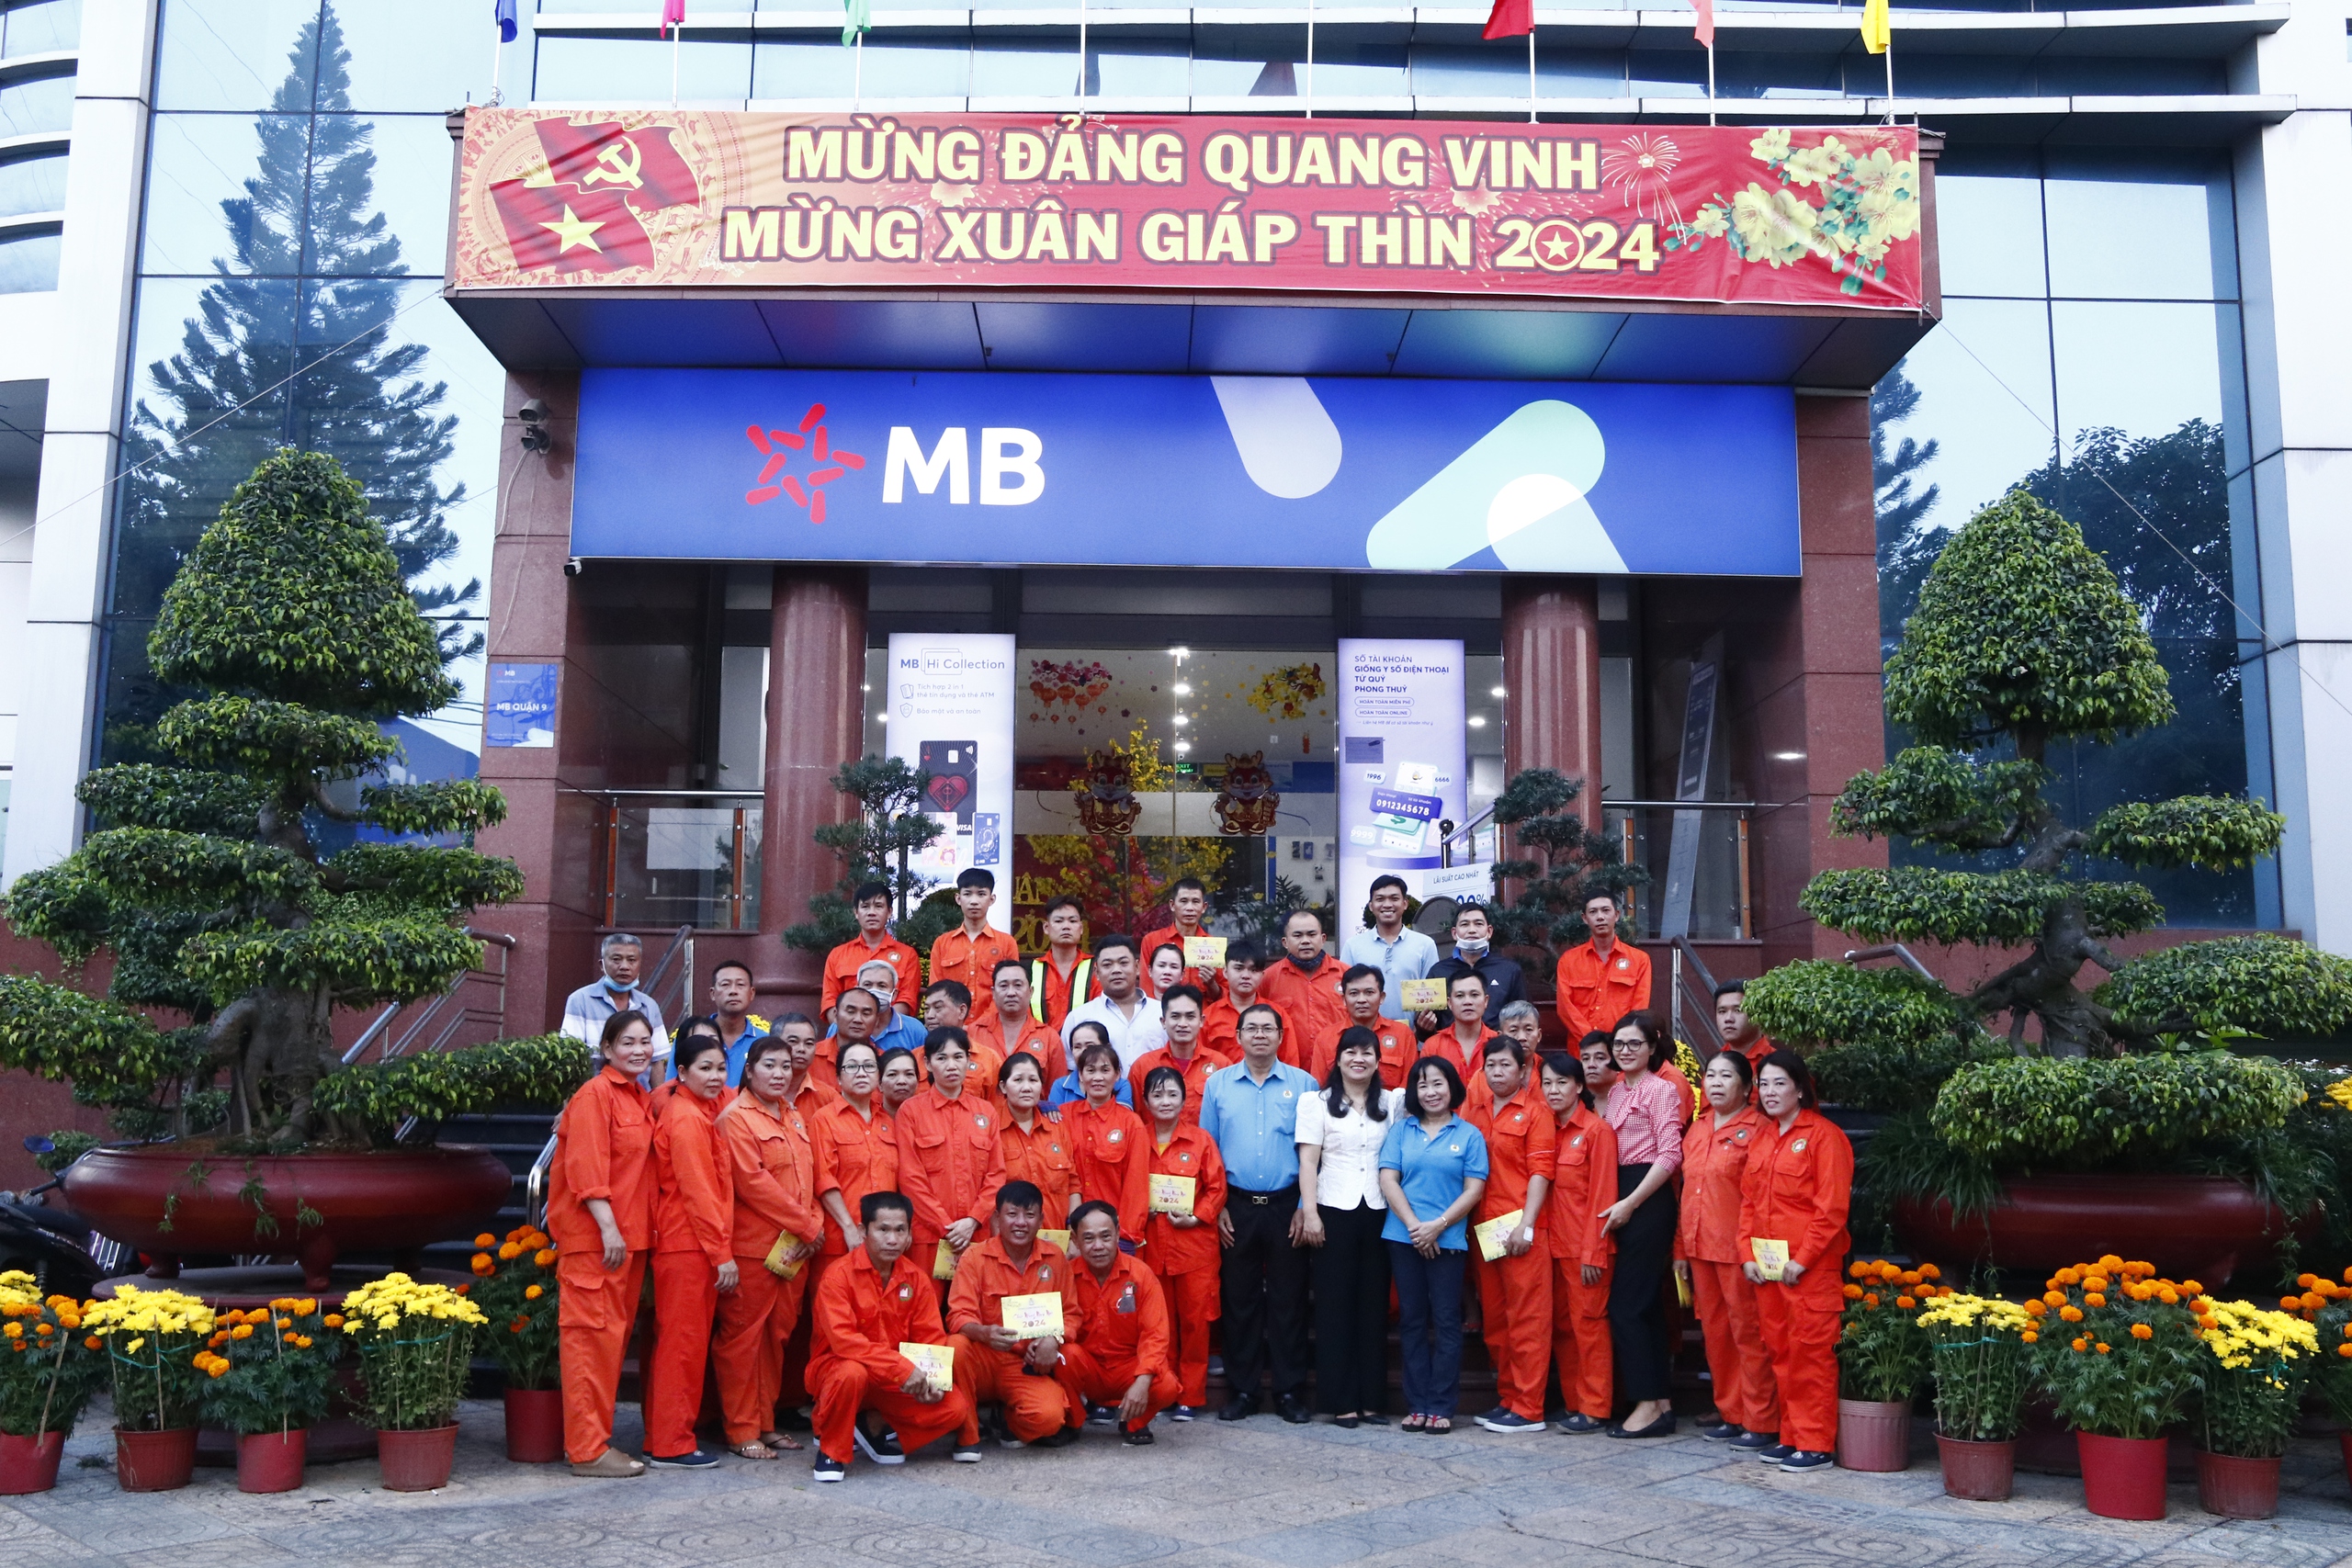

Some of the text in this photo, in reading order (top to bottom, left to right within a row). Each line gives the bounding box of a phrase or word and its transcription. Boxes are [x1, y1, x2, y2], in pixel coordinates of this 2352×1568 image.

[786, 114, 1598, 193] MỪNG ĐẢNG QUANG VINH
[722, 197, 1660, 273] MỪNG XUÂN GIÁP THÌN 2024
[882, 426, 1046, 506] MB
[1354, 654, 1412, 663] SỐ TÀI KHOẢN
[900, 659, 1005, 670] MB Hi Collection
[1354, 664, 1382, 672] GIỐNG
[1390, 664, 1402, 673] SỐ
[1403, 664, 1422, 675] ĐIỆN
[1424, 666, 1450, 675] THOẠI
[1354, 674, 1385, 682] TỨ QUÝ
[496, 703, 511, 711] MB
[512, 701, 540, 713] QUẬN
[1366, 773, 1382, 781] 1996
[1376, 798, 1430, 816] 0912345678
[1351, 829, 1374, 840] 9999
[1453, 873, 1465, 881] CAO
[1022, 1319, 1046, 1328] 2024
